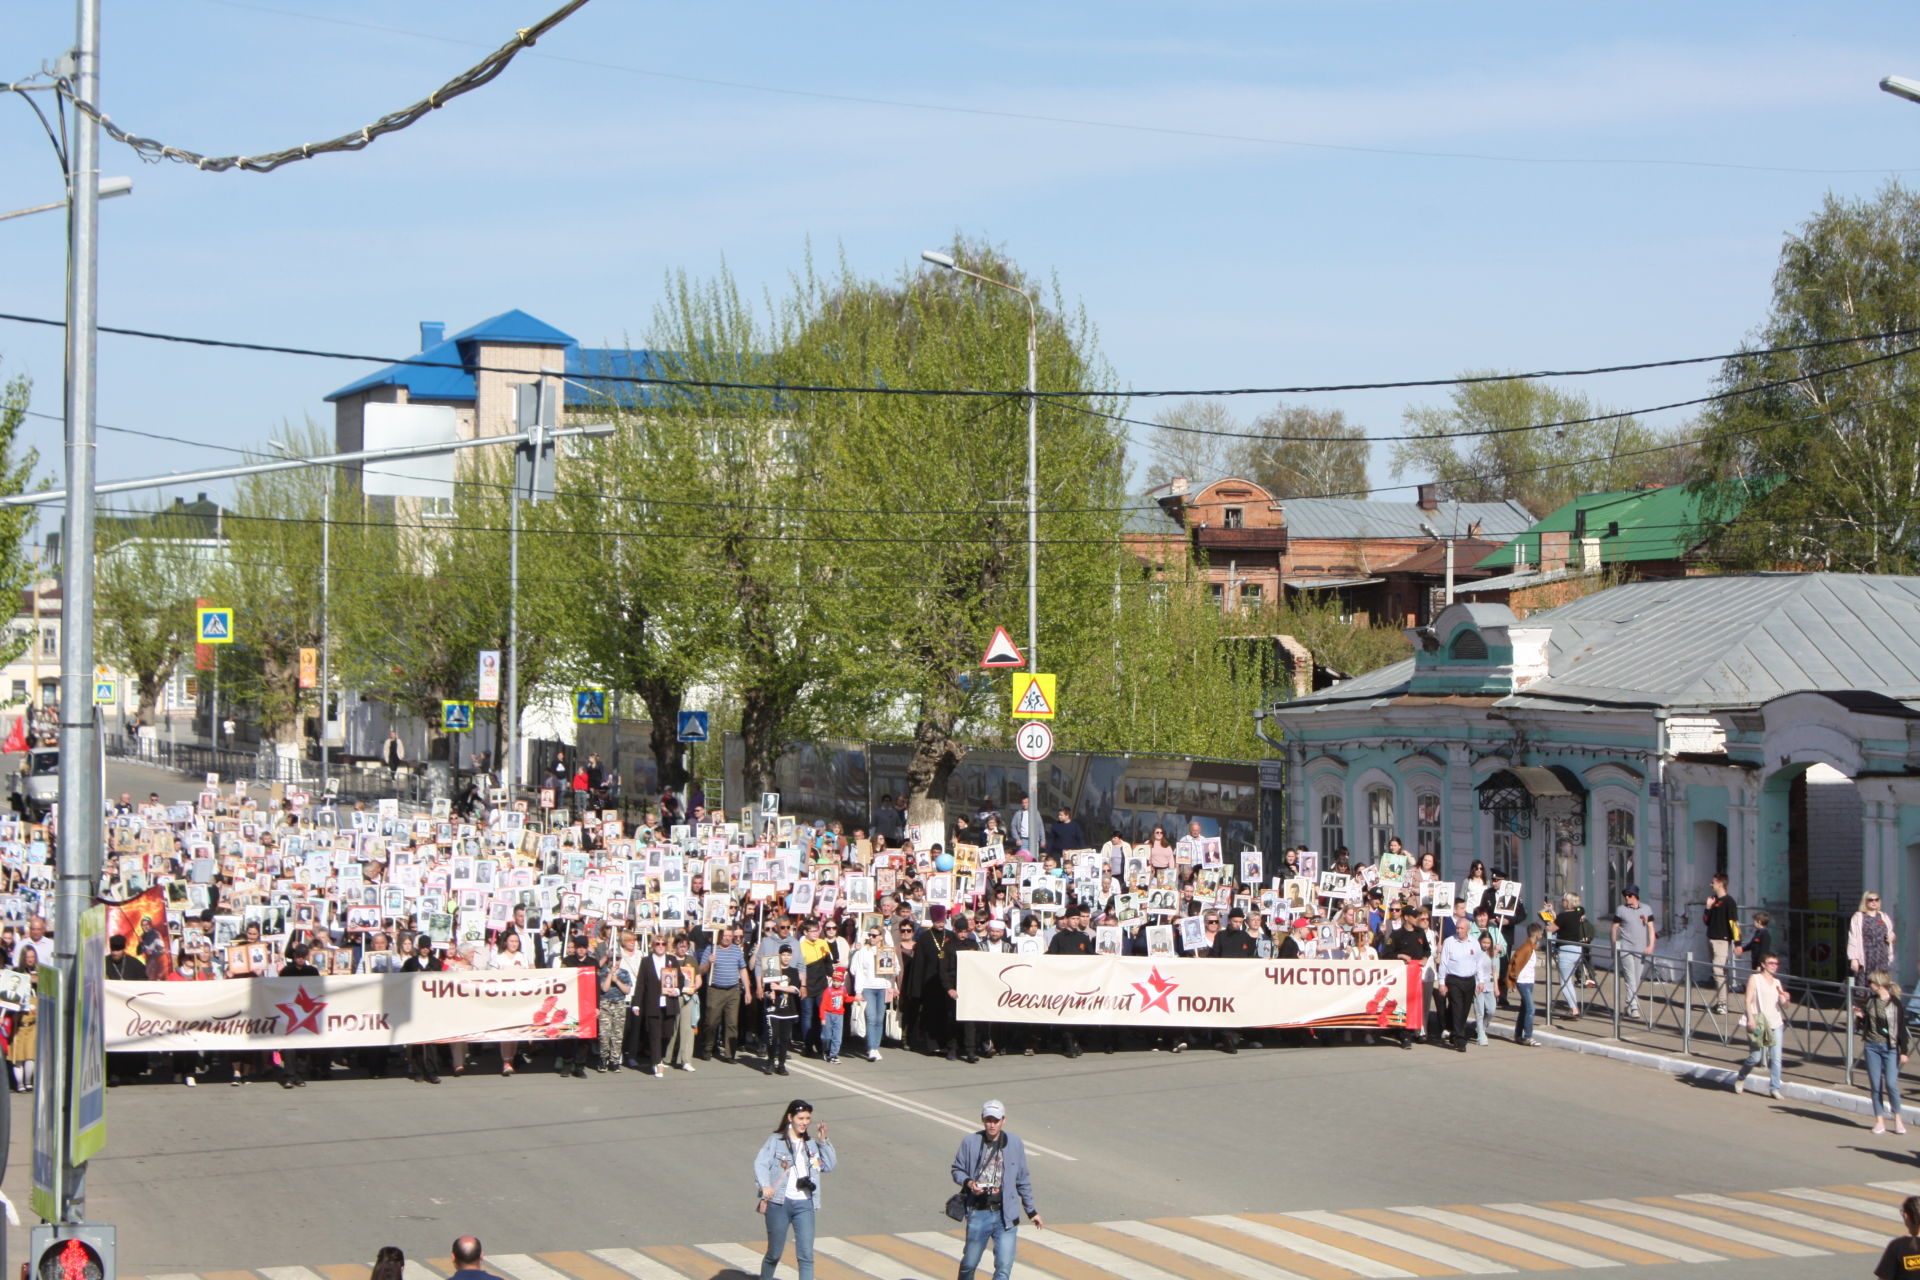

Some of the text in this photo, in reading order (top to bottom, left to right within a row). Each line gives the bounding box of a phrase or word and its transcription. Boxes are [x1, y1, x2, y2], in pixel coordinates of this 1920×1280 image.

[1026, 734, 1043, 749] 20
[1264, 966, 1397, 986] ЧИСТОПОЛЬ
[997, 963, 1136, 1016] бессмертный
